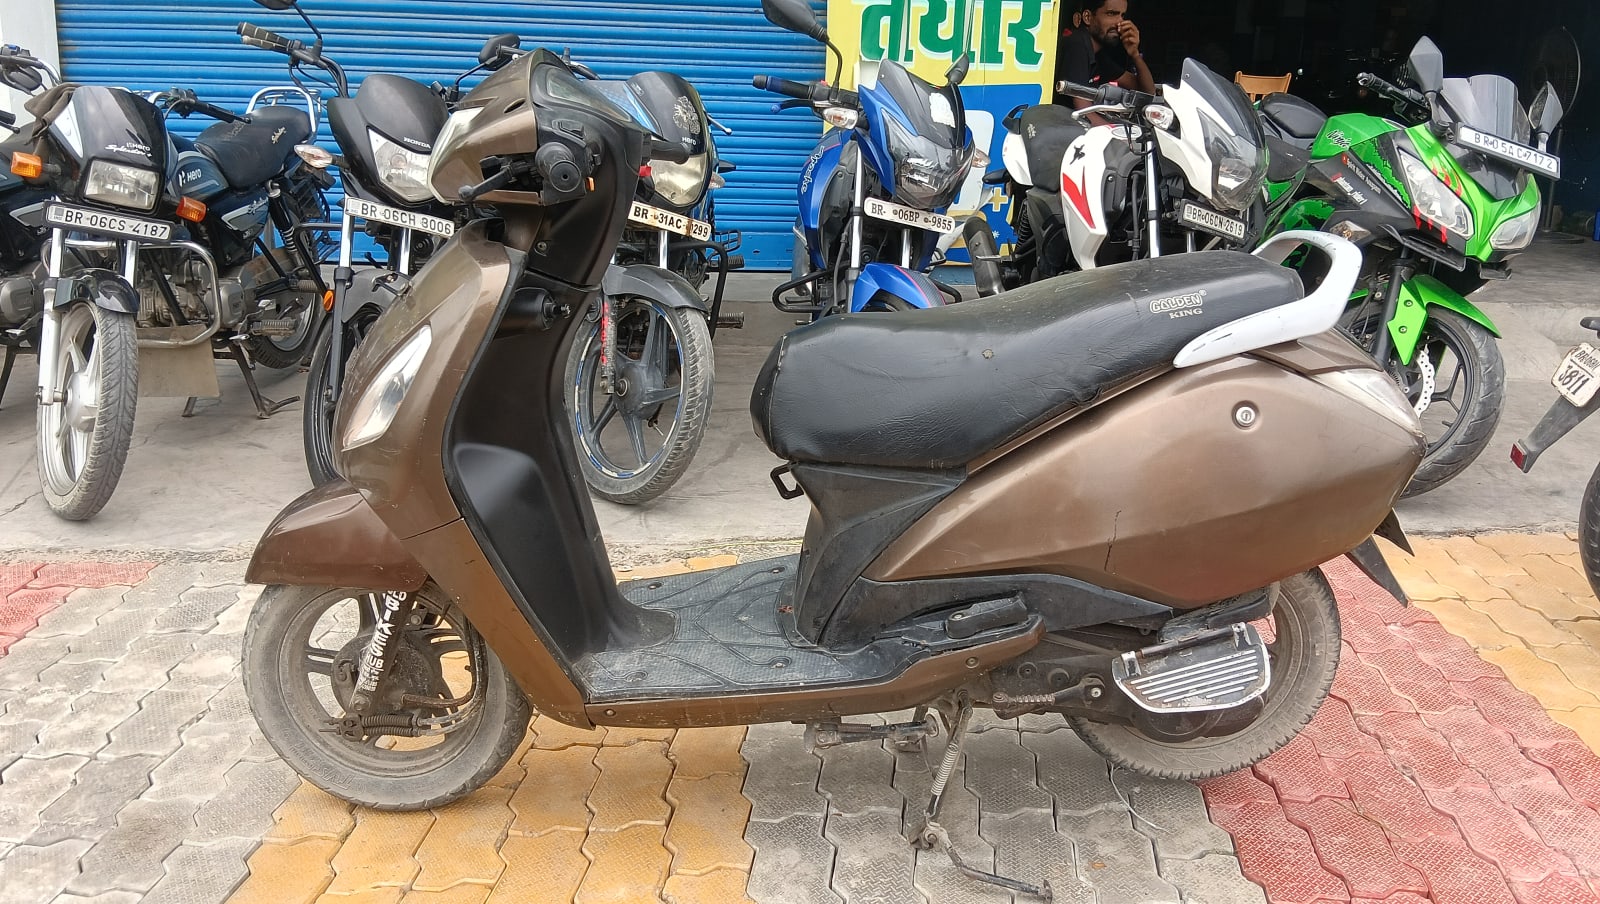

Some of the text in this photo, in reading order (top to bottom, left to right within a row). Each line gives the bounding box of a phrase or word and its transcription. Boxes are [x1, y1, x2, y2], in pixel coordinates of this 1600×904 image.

[403, 136, 431, 149] HONDA
[682, 136, 697, 146] Hero
[186, 168, 202, 182] Hero
[361, 203, 377, 218] BR
[383, 208, 416, 226] 06CH
[898, 209, 920, 223] 06BP
[64, 210, 83, 224] BR
[89, 214, 126, 231] 06CS
[132, 223, 168, 238] 4187
[1169, 307, 1203, 319] KING
[1558, 365, 1590, 395] 3811
[370, 594, 400, 657] BIKES
[366, 653, 384, 669] HUB
